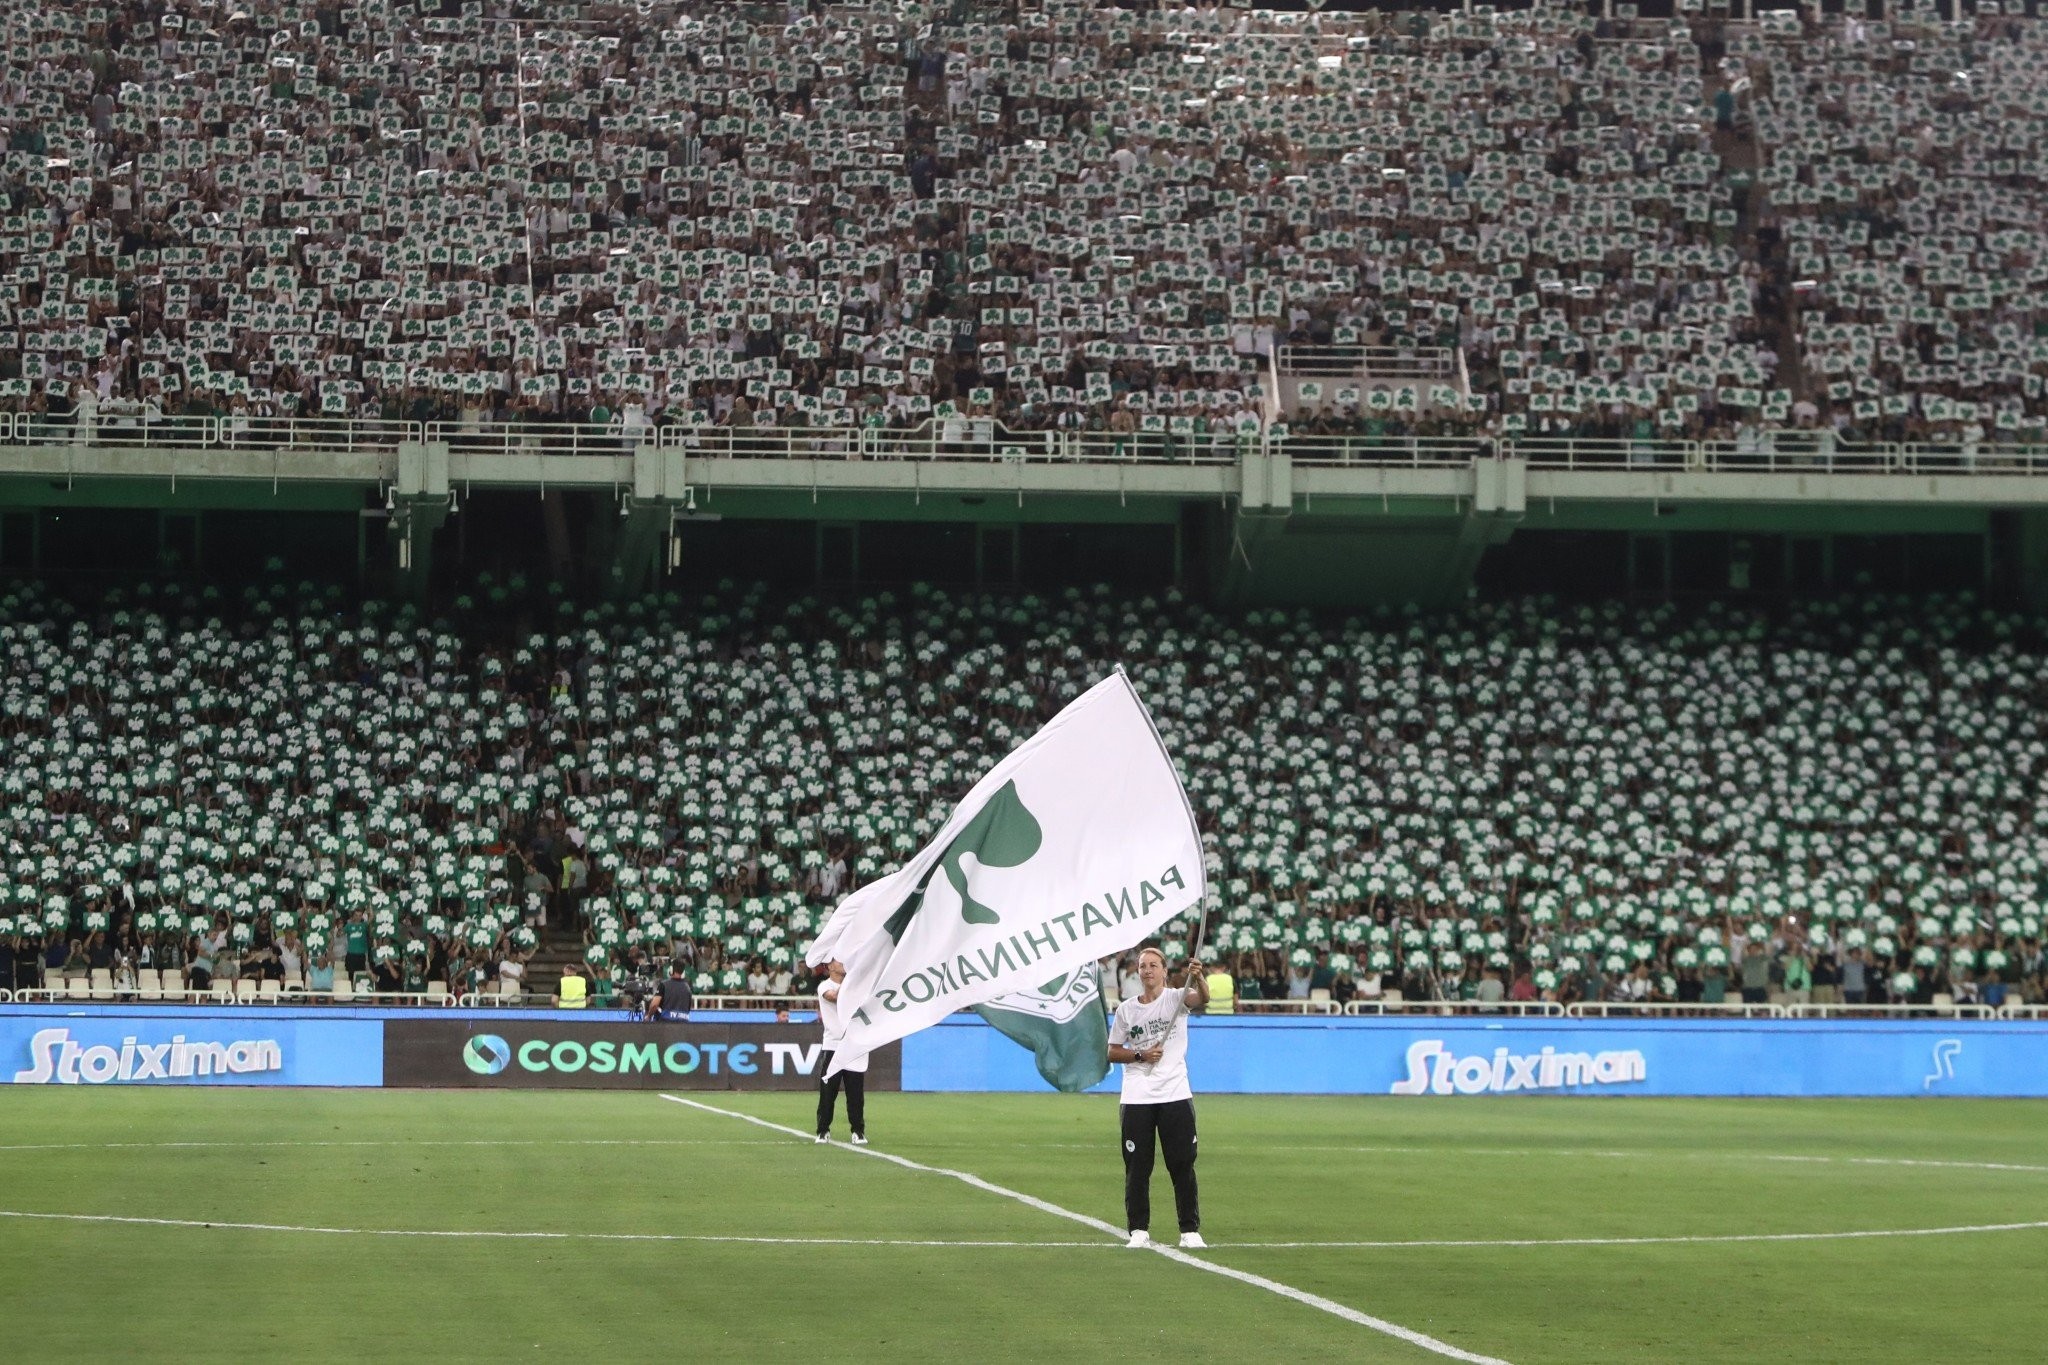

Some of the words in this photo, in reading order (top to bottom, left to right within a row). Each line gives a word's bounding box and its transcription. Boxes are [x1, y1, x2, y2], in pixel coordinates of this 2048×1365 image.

[960, 322, 973, 336] 10
[14, 1028, 282, 1084] Stoiximan
[763, 1042, 823, 1075] TV
[1390, 1039, 1646, 1095] Stoiximan
